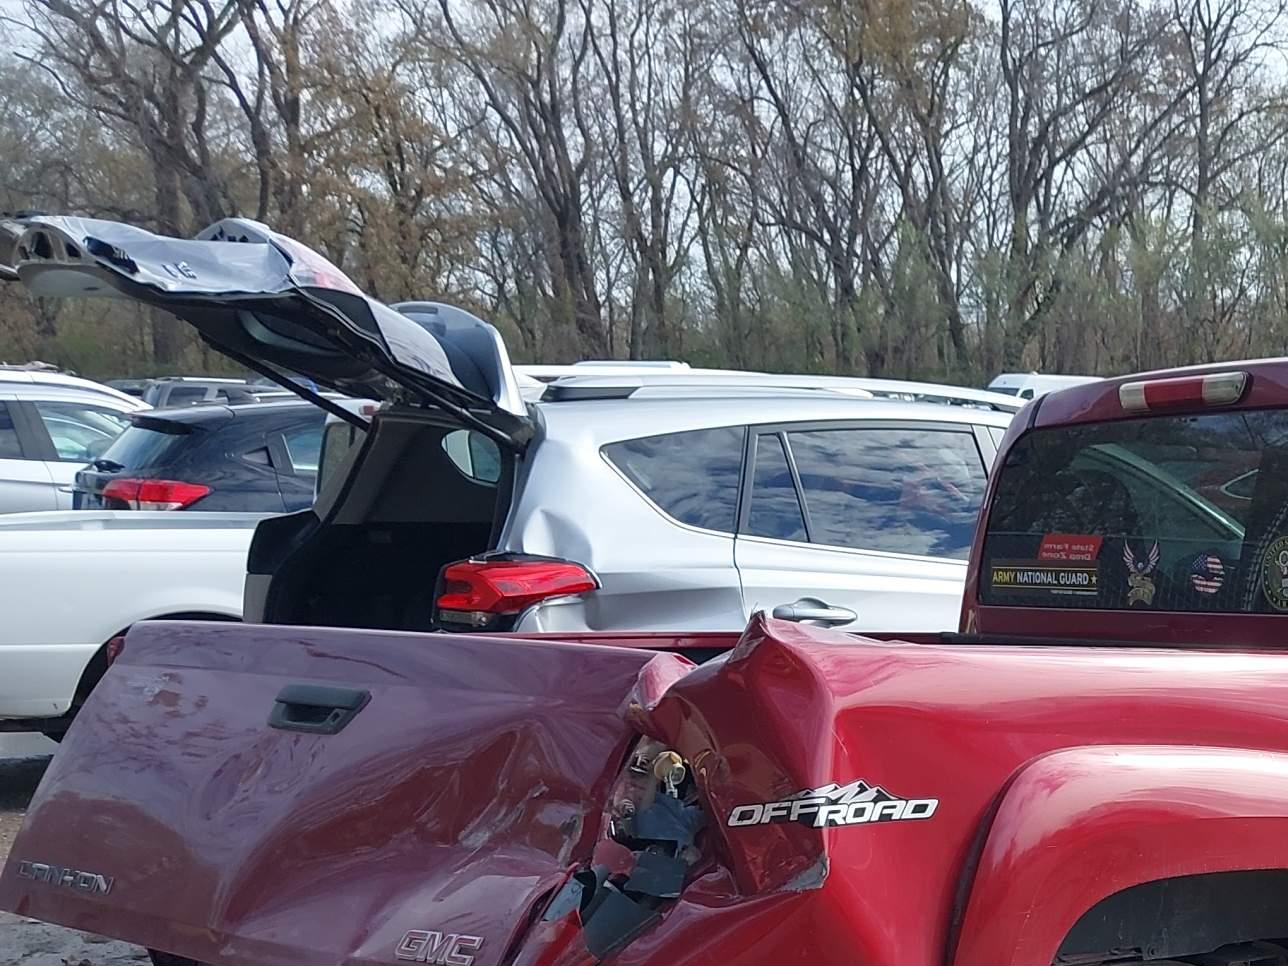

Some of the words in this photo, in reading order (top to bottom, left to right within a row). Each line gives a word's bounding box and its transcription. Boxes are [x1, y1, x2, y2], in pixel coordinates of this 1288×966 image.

[992, 571, 1016, 582] ARMY
[1016, 571, 1058, 585] NATIONAL
[1059, 572, 1089, 585] GUARD
